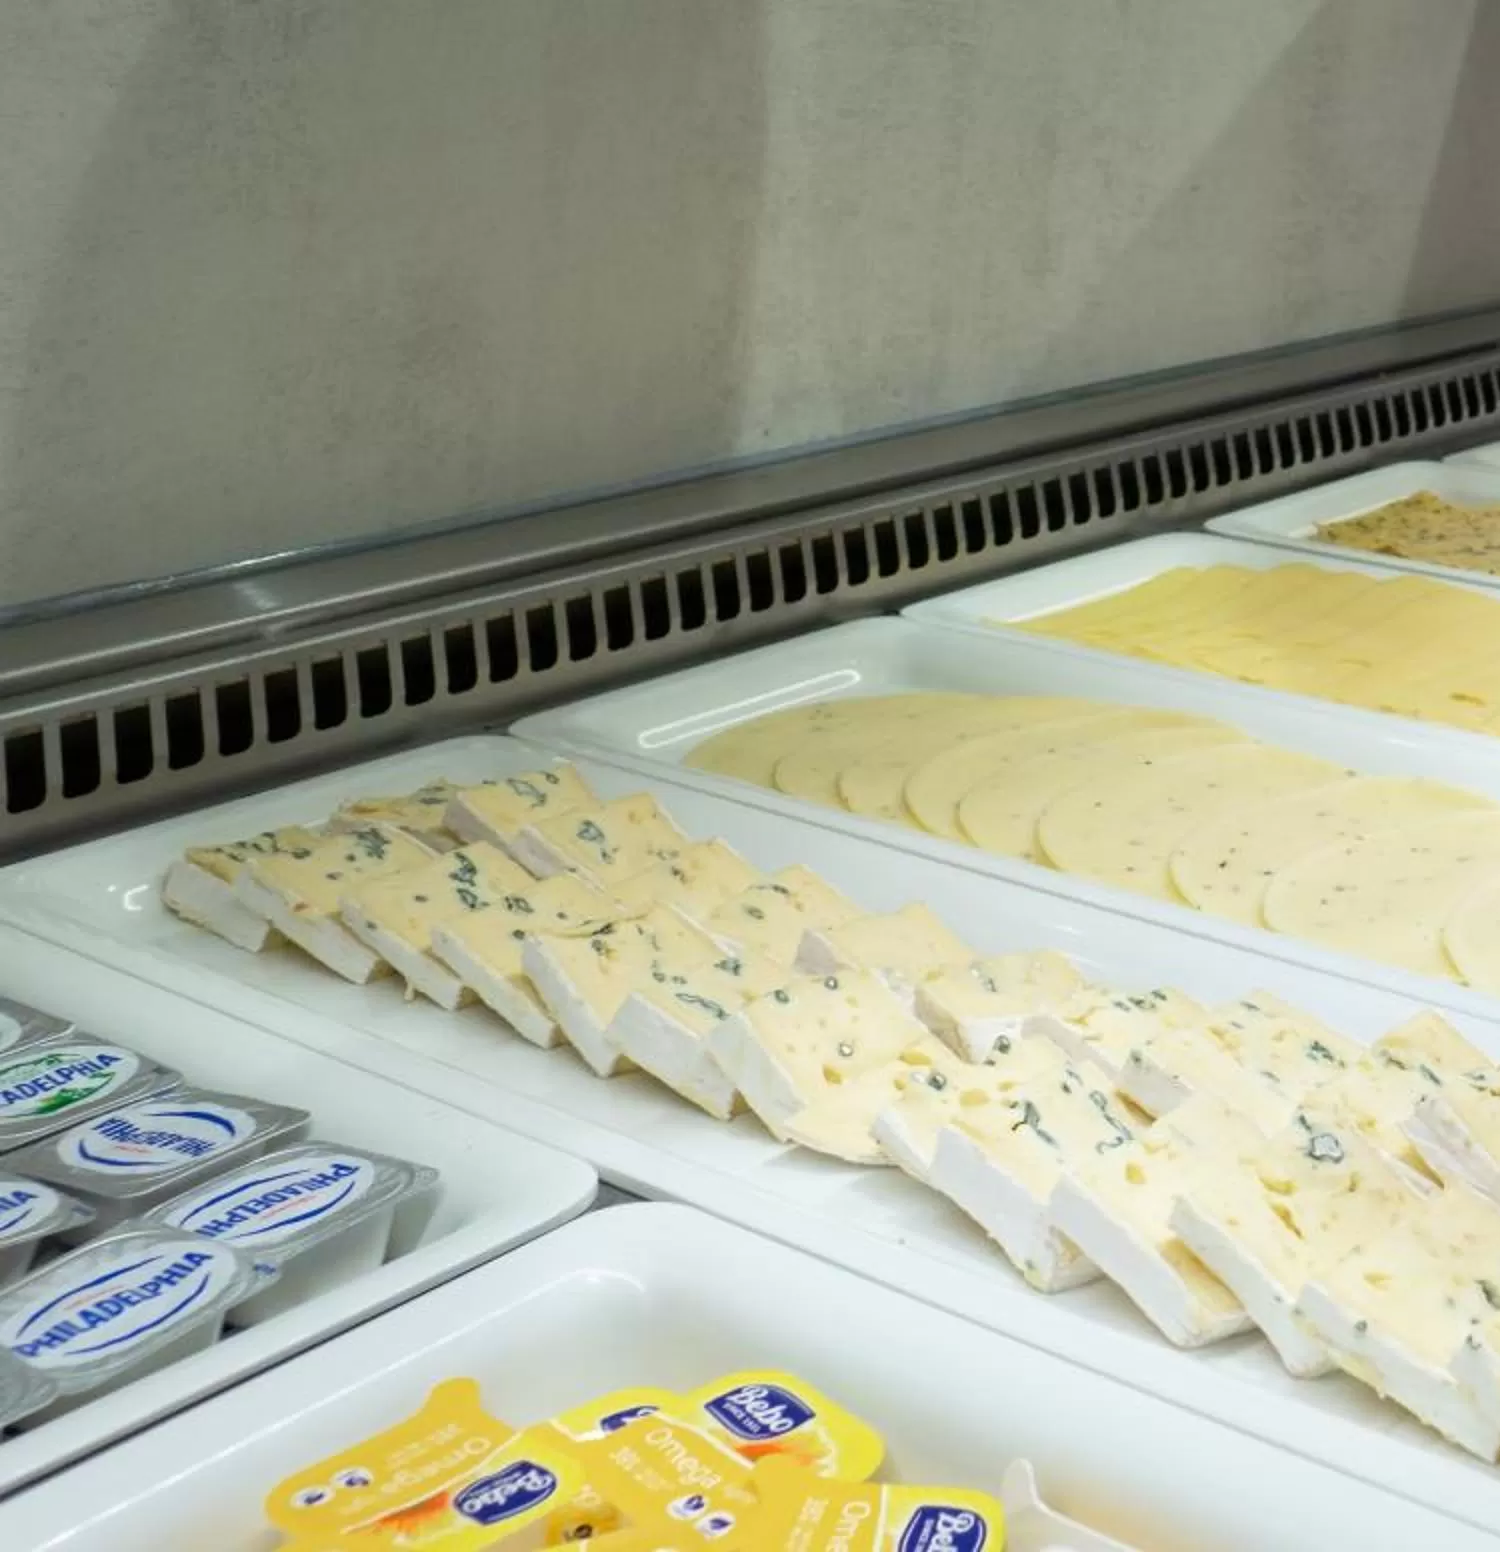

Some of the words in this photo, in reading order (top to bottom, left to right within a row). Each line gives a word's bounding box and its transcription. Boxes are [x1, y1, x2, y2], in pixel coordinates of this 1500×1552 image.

[195, 1163, 360, 1238] PHILADELPHI
[12, 1251, 214, 1358] PHILADELPHIA
[725, 1386, 795, 1433] Bebo
[643, 1431, 722, 1490] Omega
